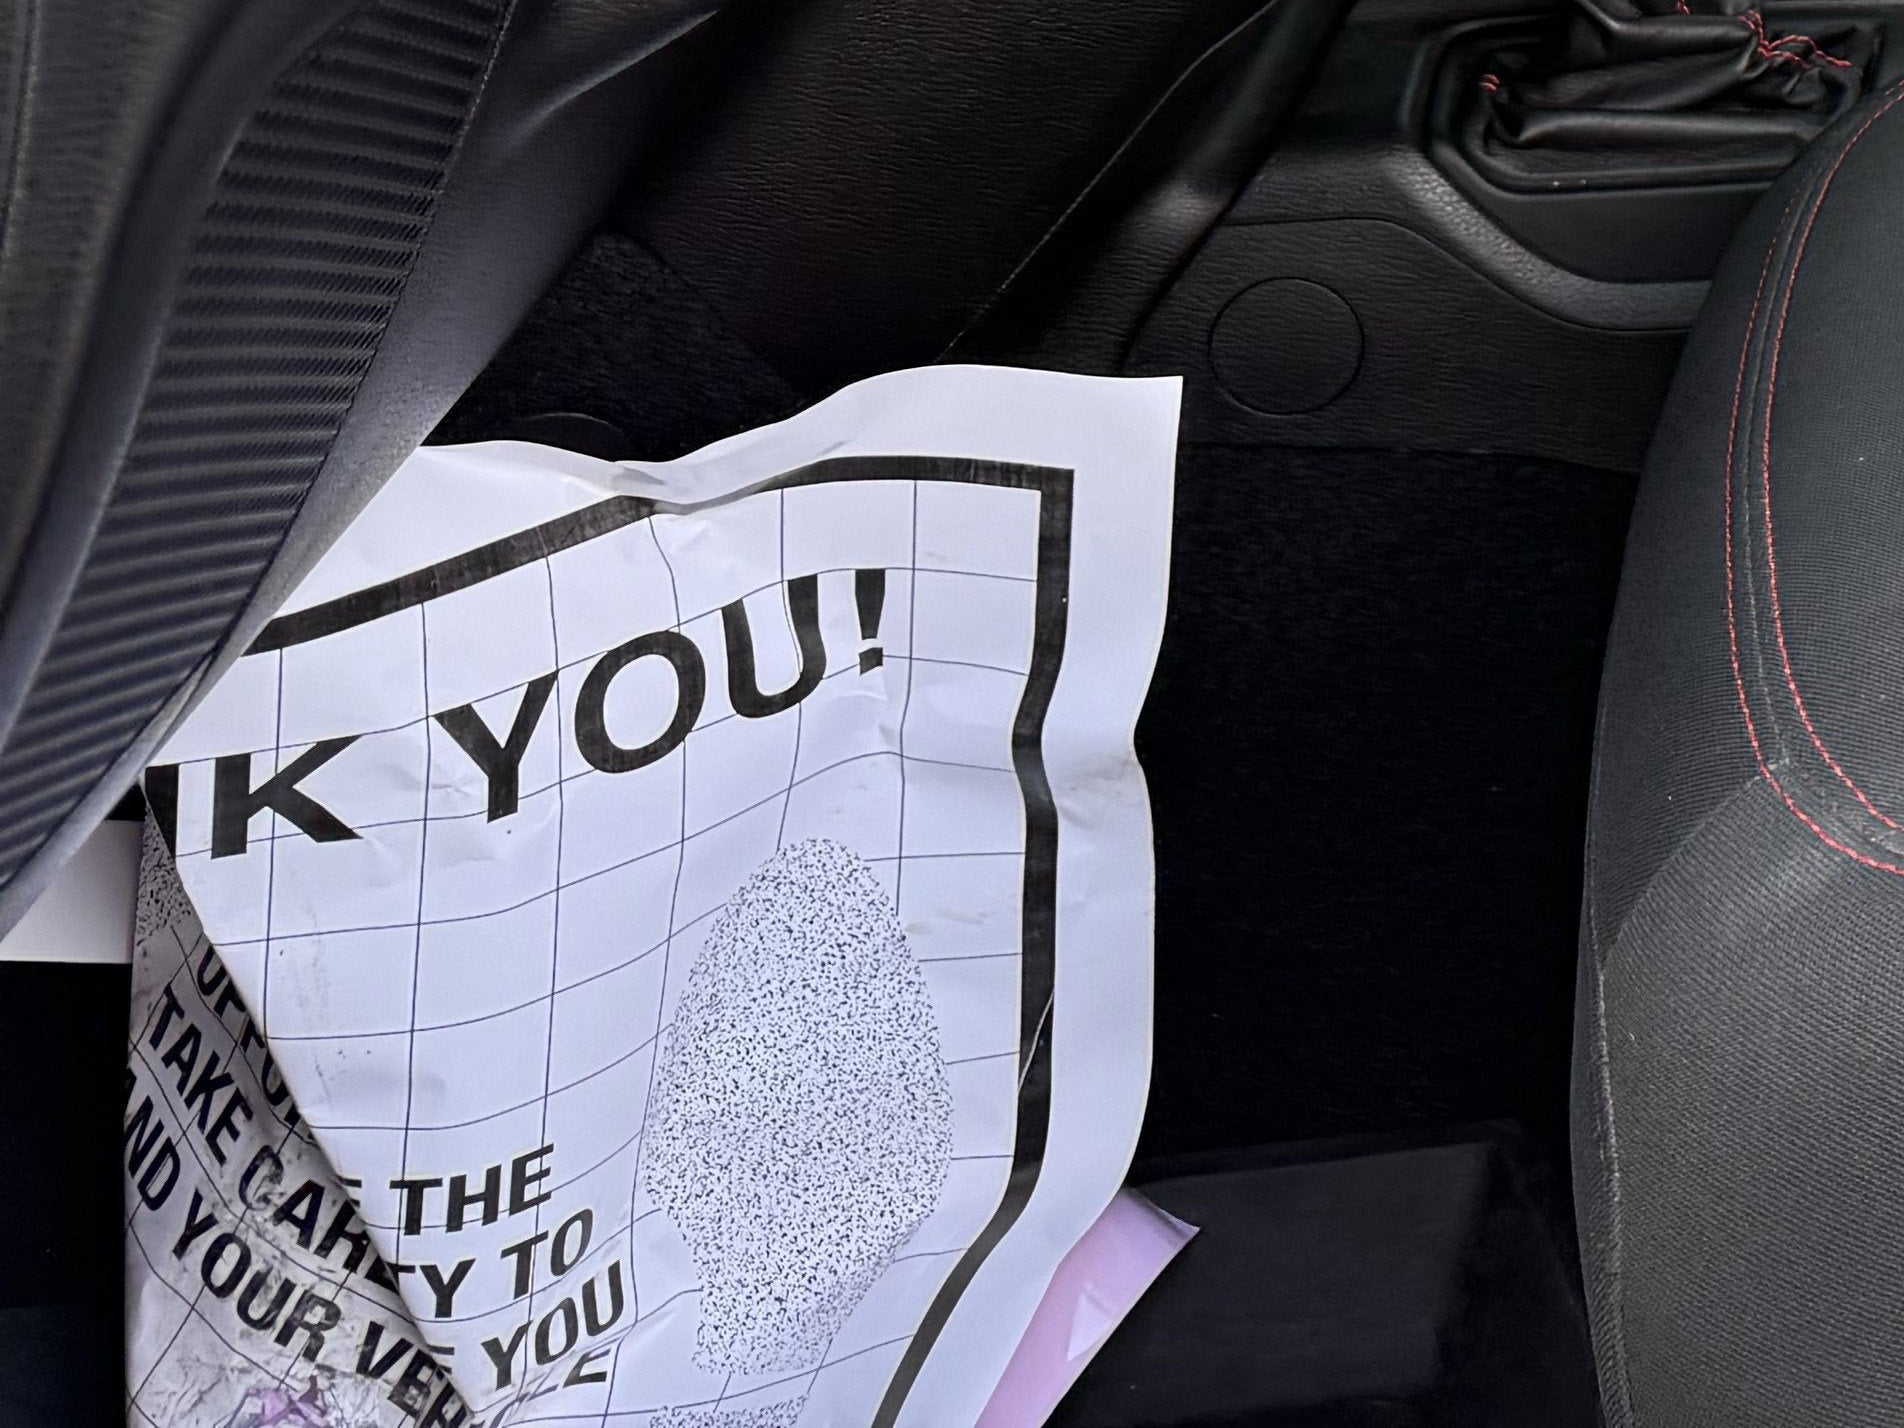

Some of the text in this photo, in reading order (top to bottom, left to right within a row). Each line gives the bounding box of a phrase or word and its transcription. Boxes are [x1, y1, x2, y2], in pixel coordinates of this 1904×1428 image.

[435, 568, 887, 822] YOU!
[150, 984, 253, 1166] TAKE
[125, 1068, 181, 1211] ND
[172, 1187, 342, 1362] YOUR
[390, 1142, 555, 1236] THE
[501, 1208, 593, 1300] TO
[482, 1259, 625, 1391] YOU
